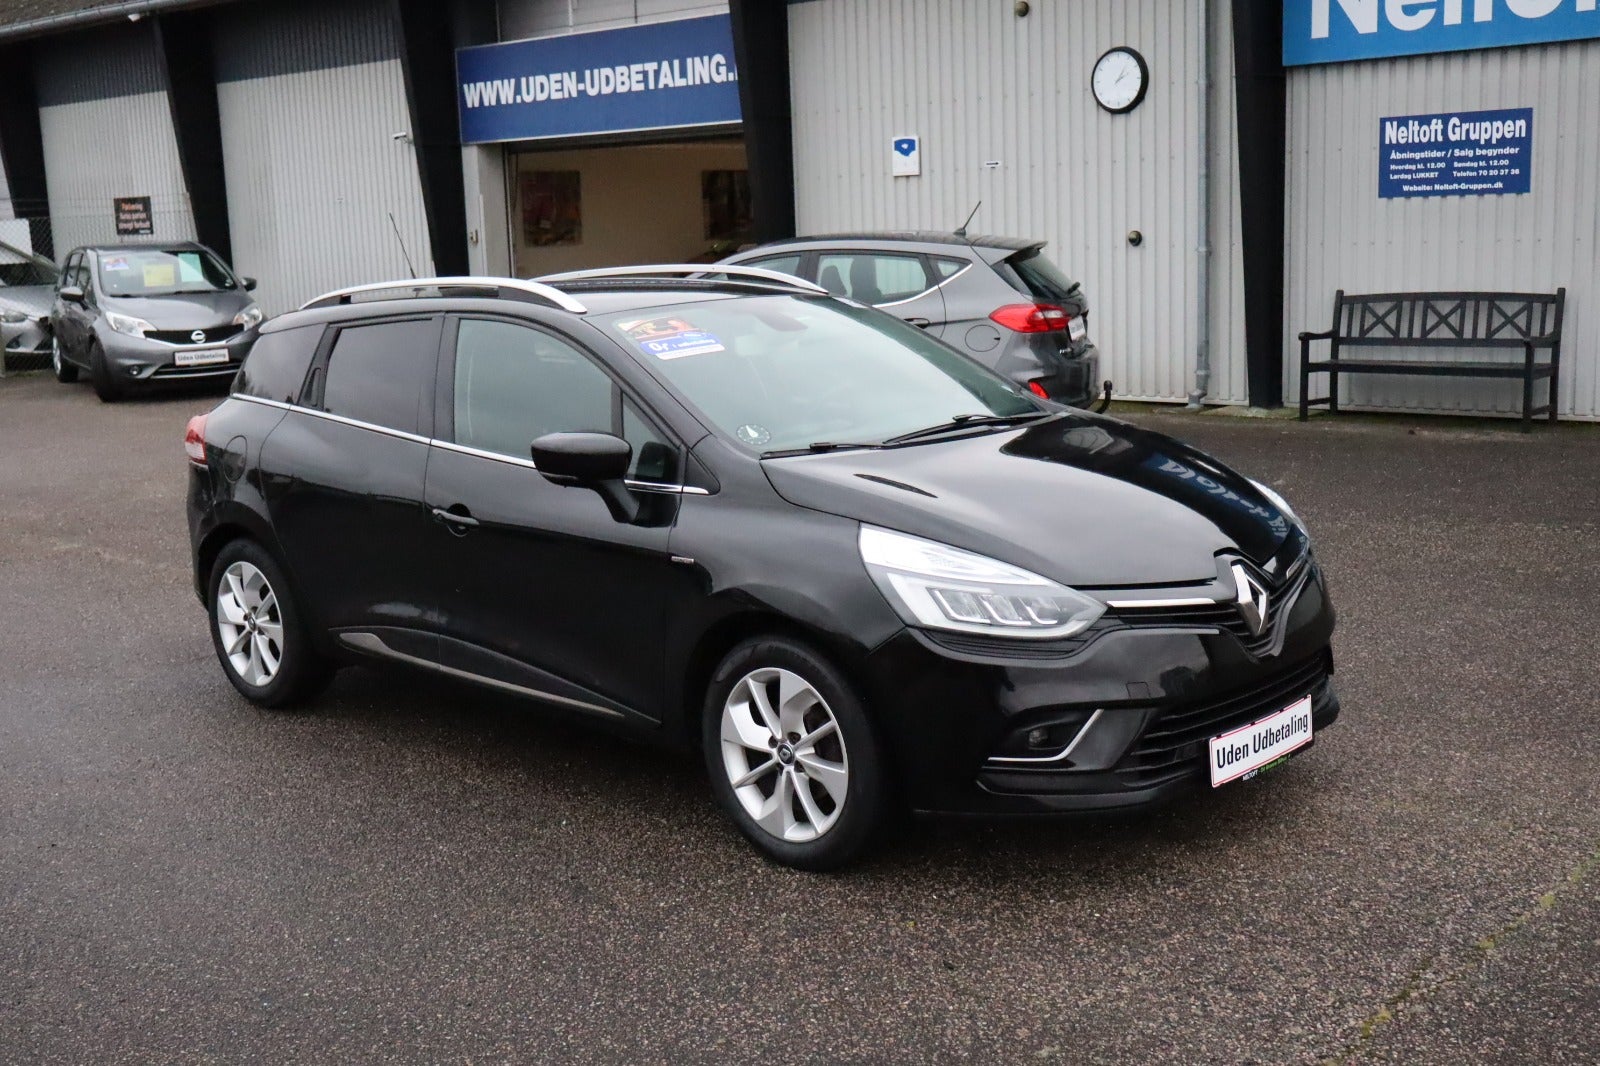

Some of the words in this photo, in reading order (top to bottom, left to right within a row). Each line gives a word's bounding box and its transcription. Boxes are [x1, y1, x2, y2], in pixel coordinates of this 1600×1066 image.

[463, 53, 738, 108] WWW.UDEN-UDBETALING.
[1385, 118, 1443, 144] Neltoft
[1448, 117, 1526, 145] Gruppen
[1390, 149, 1446, 160] Åbningstider
[1454, 148, 1473, 158] Salg
[1475, 146, 1520, 157] begynder
[1434, 181, 1503, 191] Neltoft-Gruppen.dk
[1216, 743, 1249, 769] Uden
[1253, 713, 1308, 753] Udbetaling
